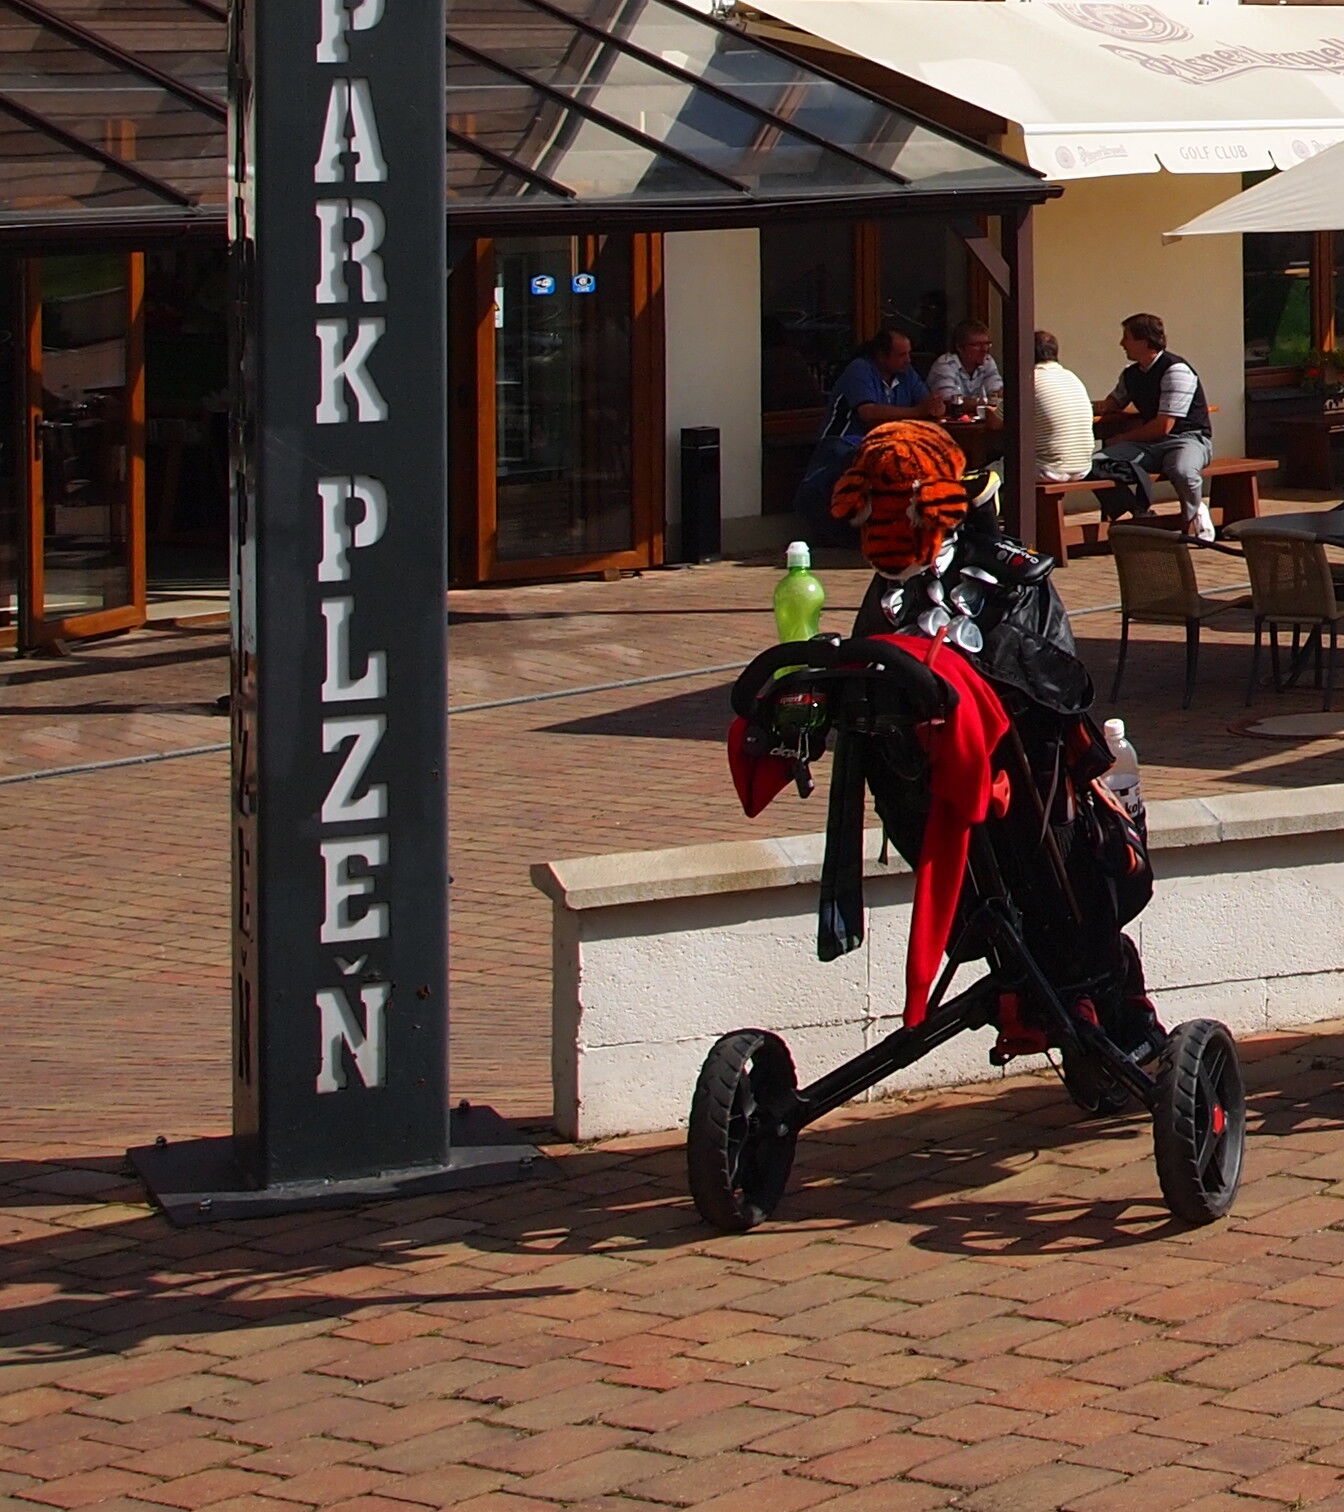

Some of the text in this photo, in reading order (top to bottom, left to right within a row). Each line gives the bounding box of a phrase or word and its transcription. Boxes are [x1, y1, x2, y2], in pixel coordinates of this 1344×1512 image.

[1179, 144, 1249, 161] GOLF CLUB
[316, 474, 394, 1094] PLZEŇ
